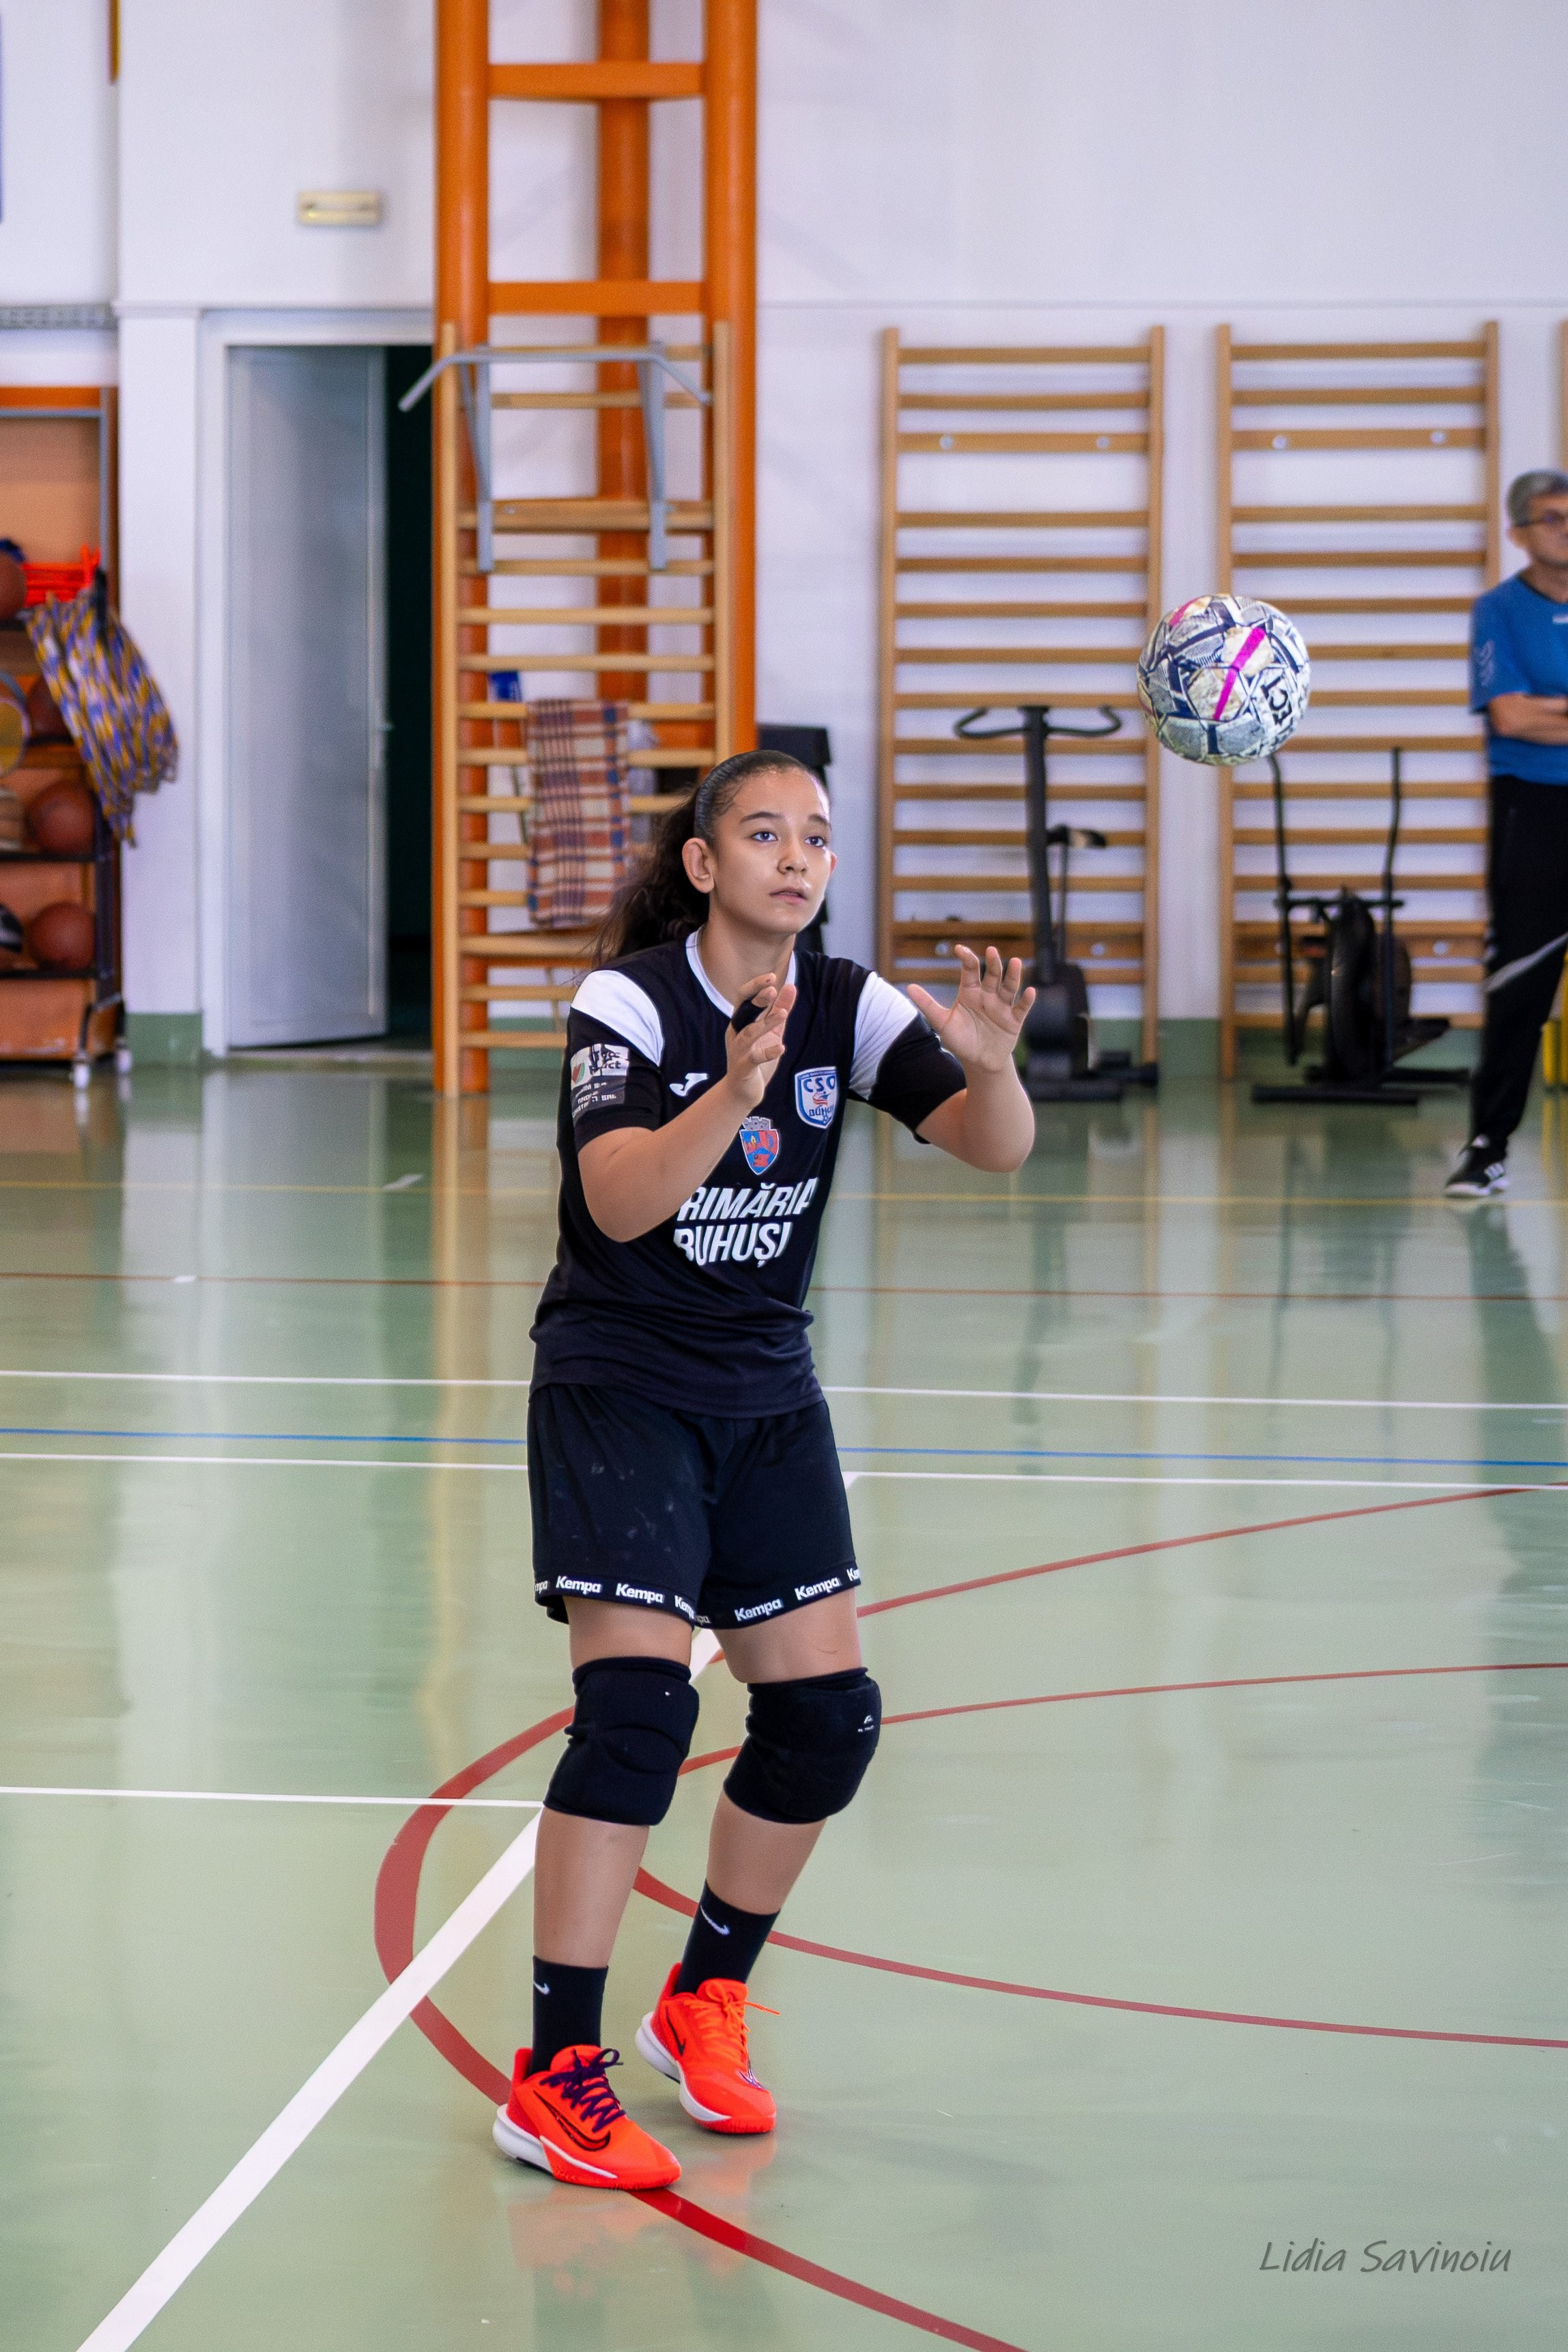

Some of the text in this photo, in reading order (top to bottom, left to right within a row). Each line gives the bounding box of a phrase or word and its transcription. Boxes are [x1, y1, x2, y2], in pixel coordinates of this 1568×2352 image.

[803, 1075, 836, 1092] CSO
[676, 1177, 818, 1221] RIMĂRIA
[673, 1221, 793, 1268] BUHUȘI
[534, 1580, 548, 1594] mpa
[556, 1576, 601, 1594] Kempa
[616, 1583, 665, 1603] Kempa
[735, 1598, 782, 1621] Kempa
[795, 1577, 841, 1600] Kempa
